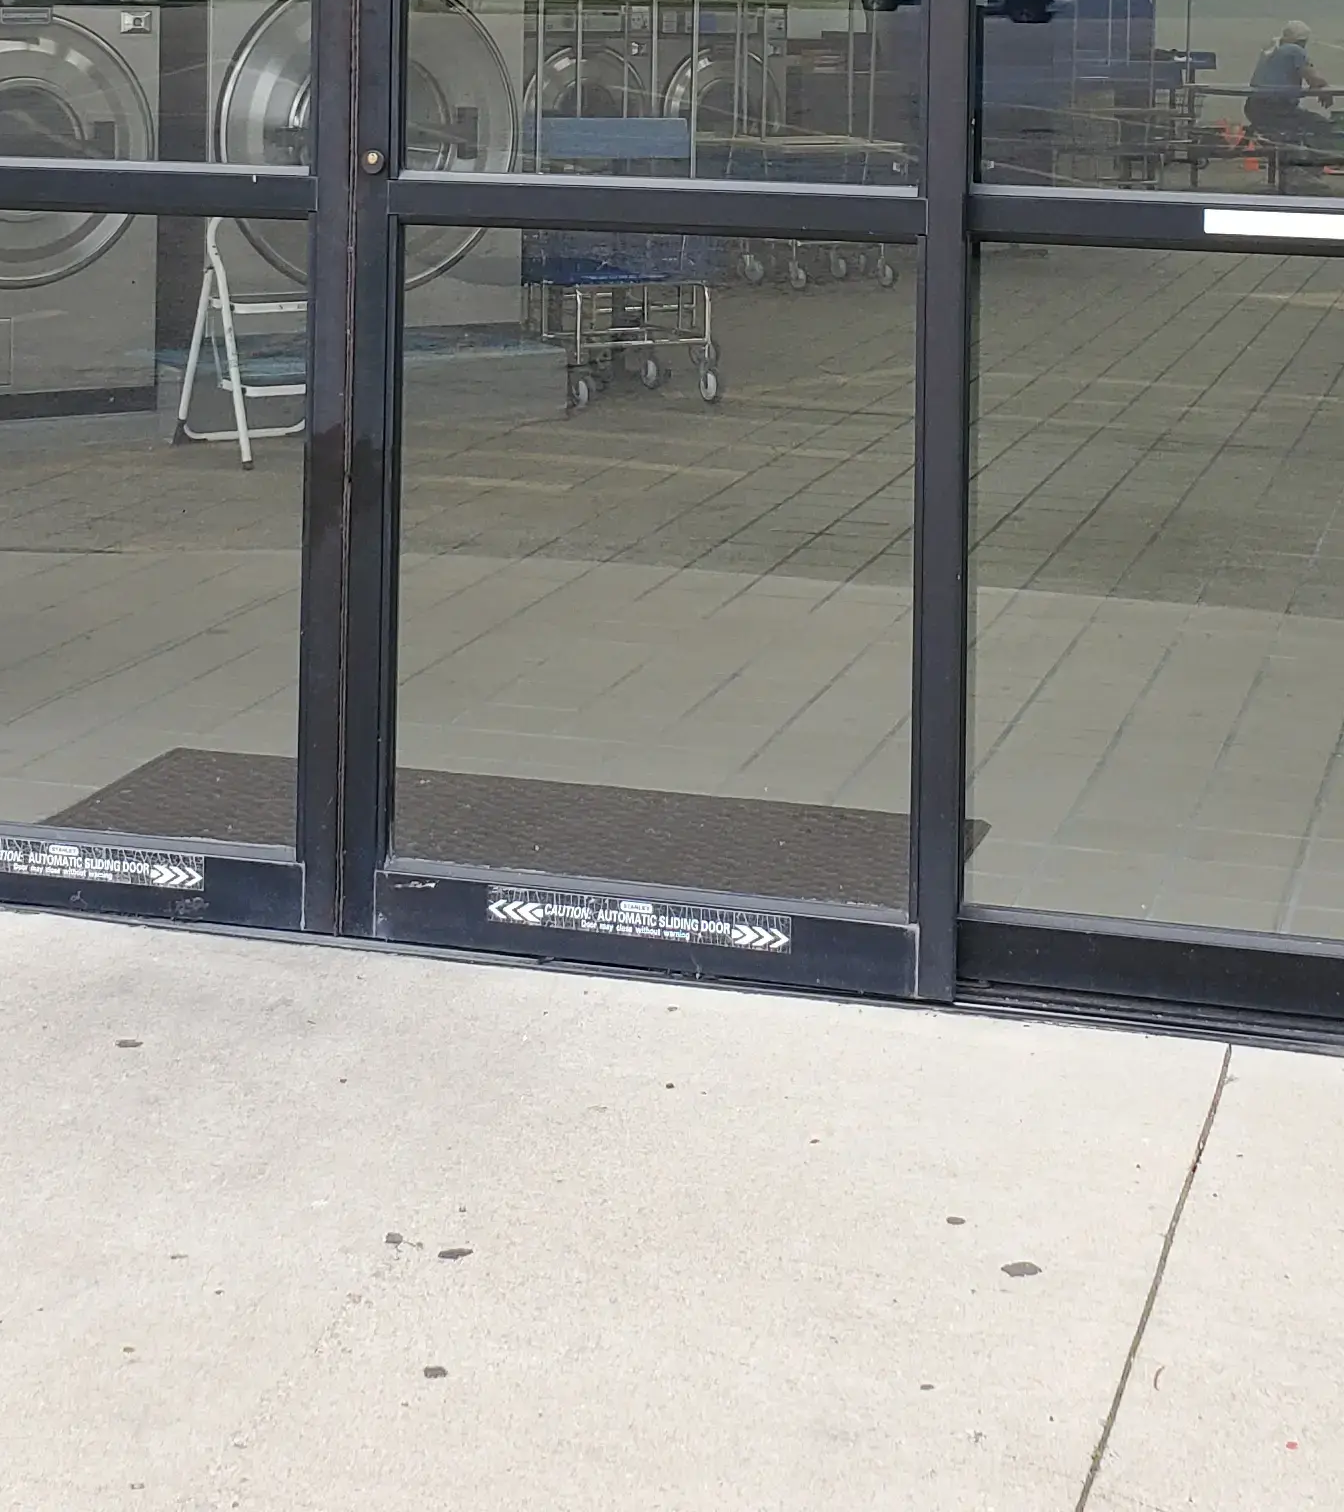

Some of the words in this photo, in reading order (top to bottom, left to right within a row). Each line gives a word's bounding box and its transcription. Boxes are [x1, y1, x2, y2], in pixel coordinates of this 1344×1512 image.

[28, 852, 83, 868] AUTOMATIC
[84, 857, 121, 873] SLIDING
[122, 861, 150, 875] DOOR
[597, 908, 657, 927] AUTOMATIC
[658, 915, 699, 931] SLIDING
[700, 919, 731, 935] DOOR
[635, 925, 661, 936] without
